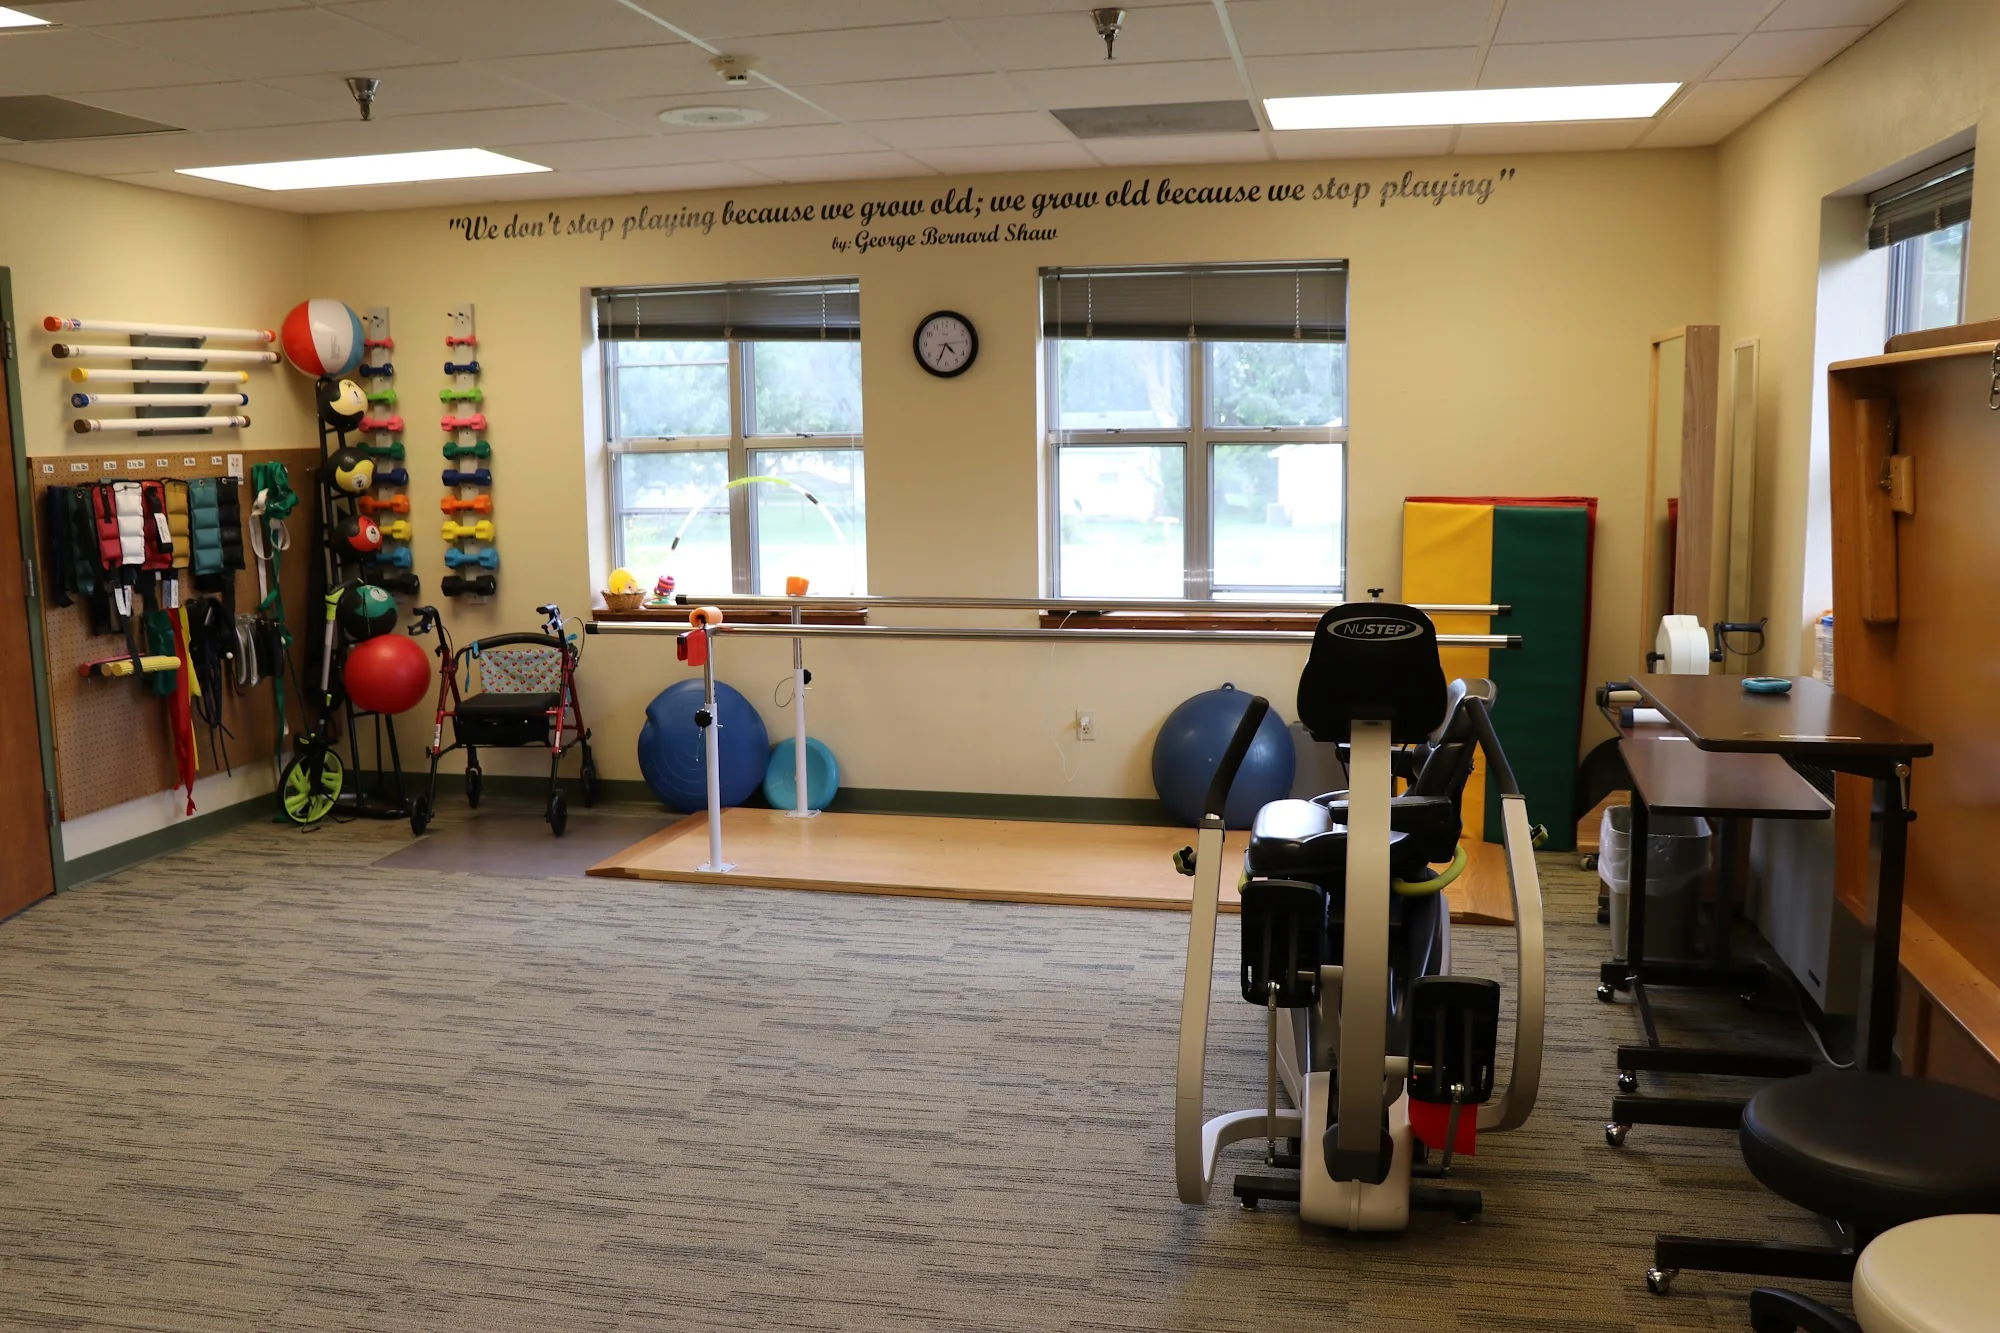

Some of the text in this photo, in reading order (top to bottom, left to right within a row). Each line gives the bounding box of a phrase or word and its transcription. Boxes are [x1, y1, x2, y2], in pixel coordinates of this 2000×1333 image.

[450, 216, 499, 241] "We
[504, 212, 561, 238] don't
[567, 214, 614, 241] stop
[622, 205, 716, 240] playing
[721, 200, 815, 226] because
[821, 202, 855, 220] we
[860, 200, 925, 226] grow
[930, 187, 982, 219] old;
[990, 194, 1026, 212] we
[1032, 191, 1099, 219] grow
[1105, 179, 1150, 207] old
[1156, 178, 1261, 205] because
[1268, 184, 1306, 201] we
[1312, 177, 1371, 208] stop
[832, 223, 1058, 254] by: George Bernard Shaw
